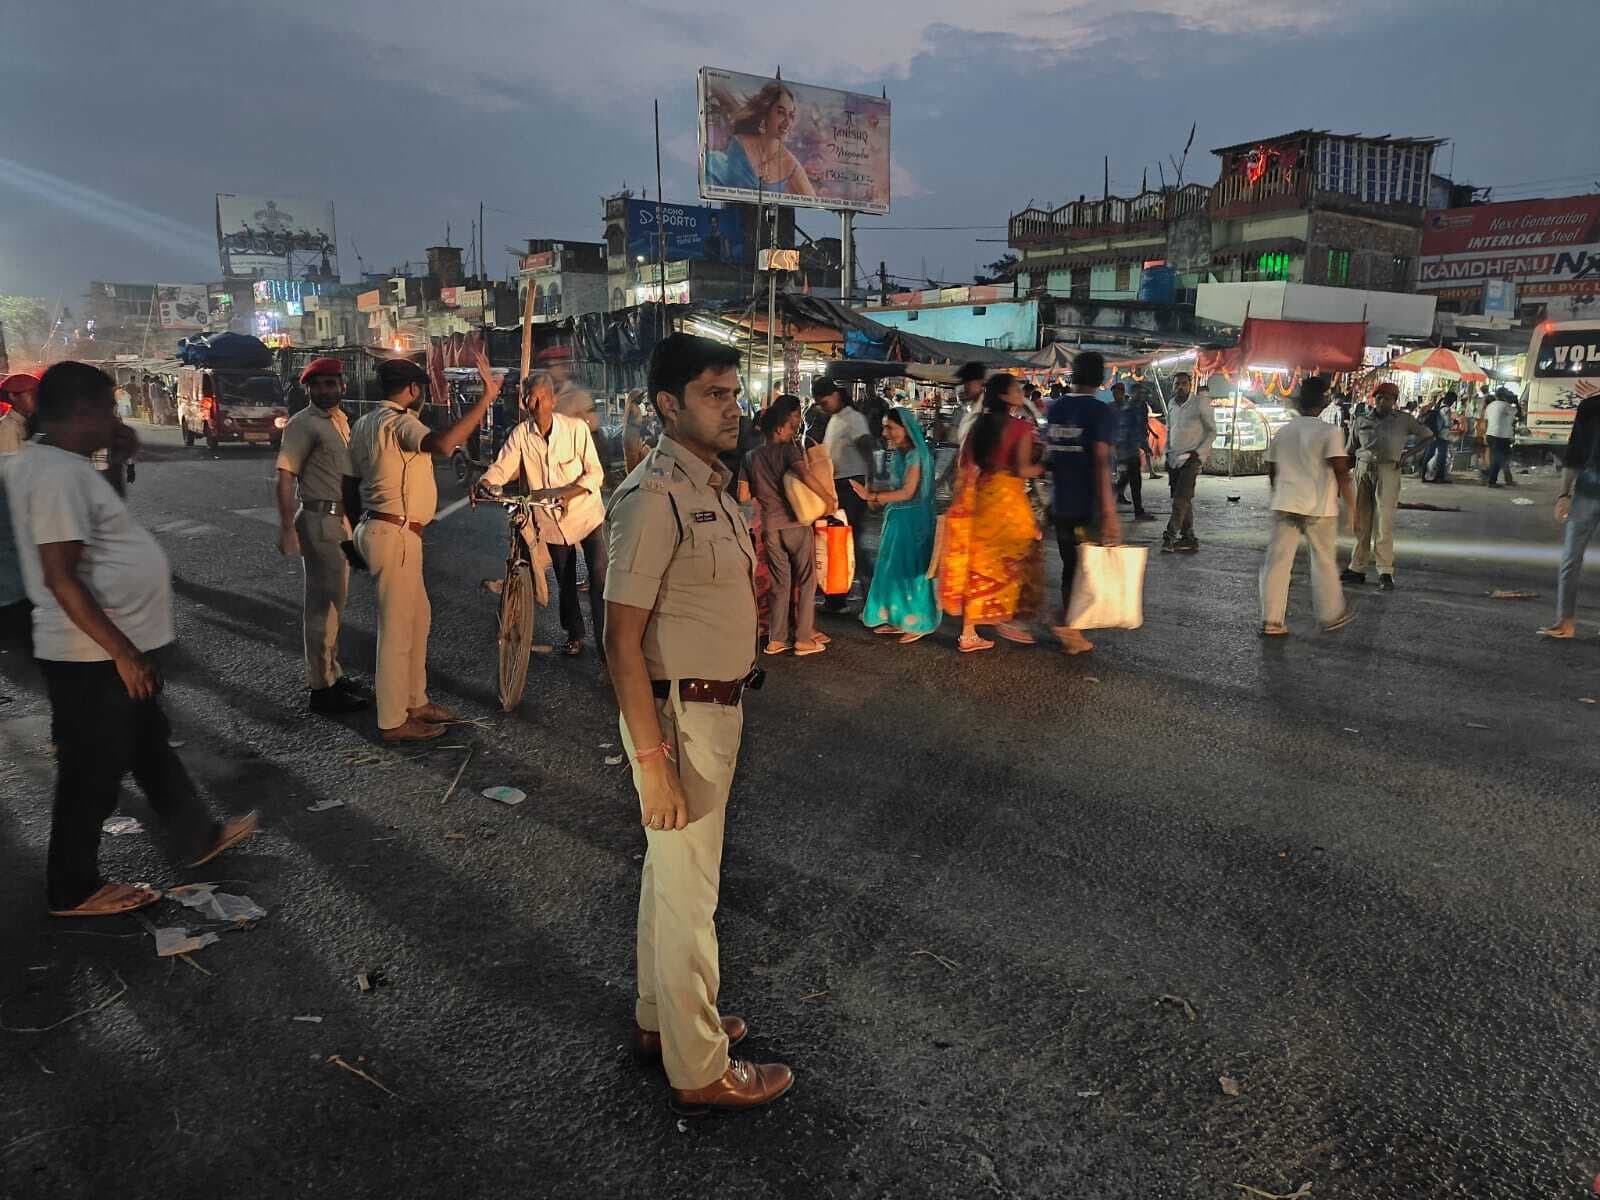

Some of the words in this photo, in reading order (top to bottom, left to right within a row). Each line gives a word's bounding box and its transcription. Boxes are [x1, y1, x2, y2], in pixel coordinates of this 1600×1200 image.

[1489, 217, 1519, 232] Next
[1520, 210, 1588, 228] Generation
[1468, 231, 1546, 248] INTERLOCK
[1549, 228, 1580, 242] Steel
[1423, 255, 1550, 280] KAMDHENU
